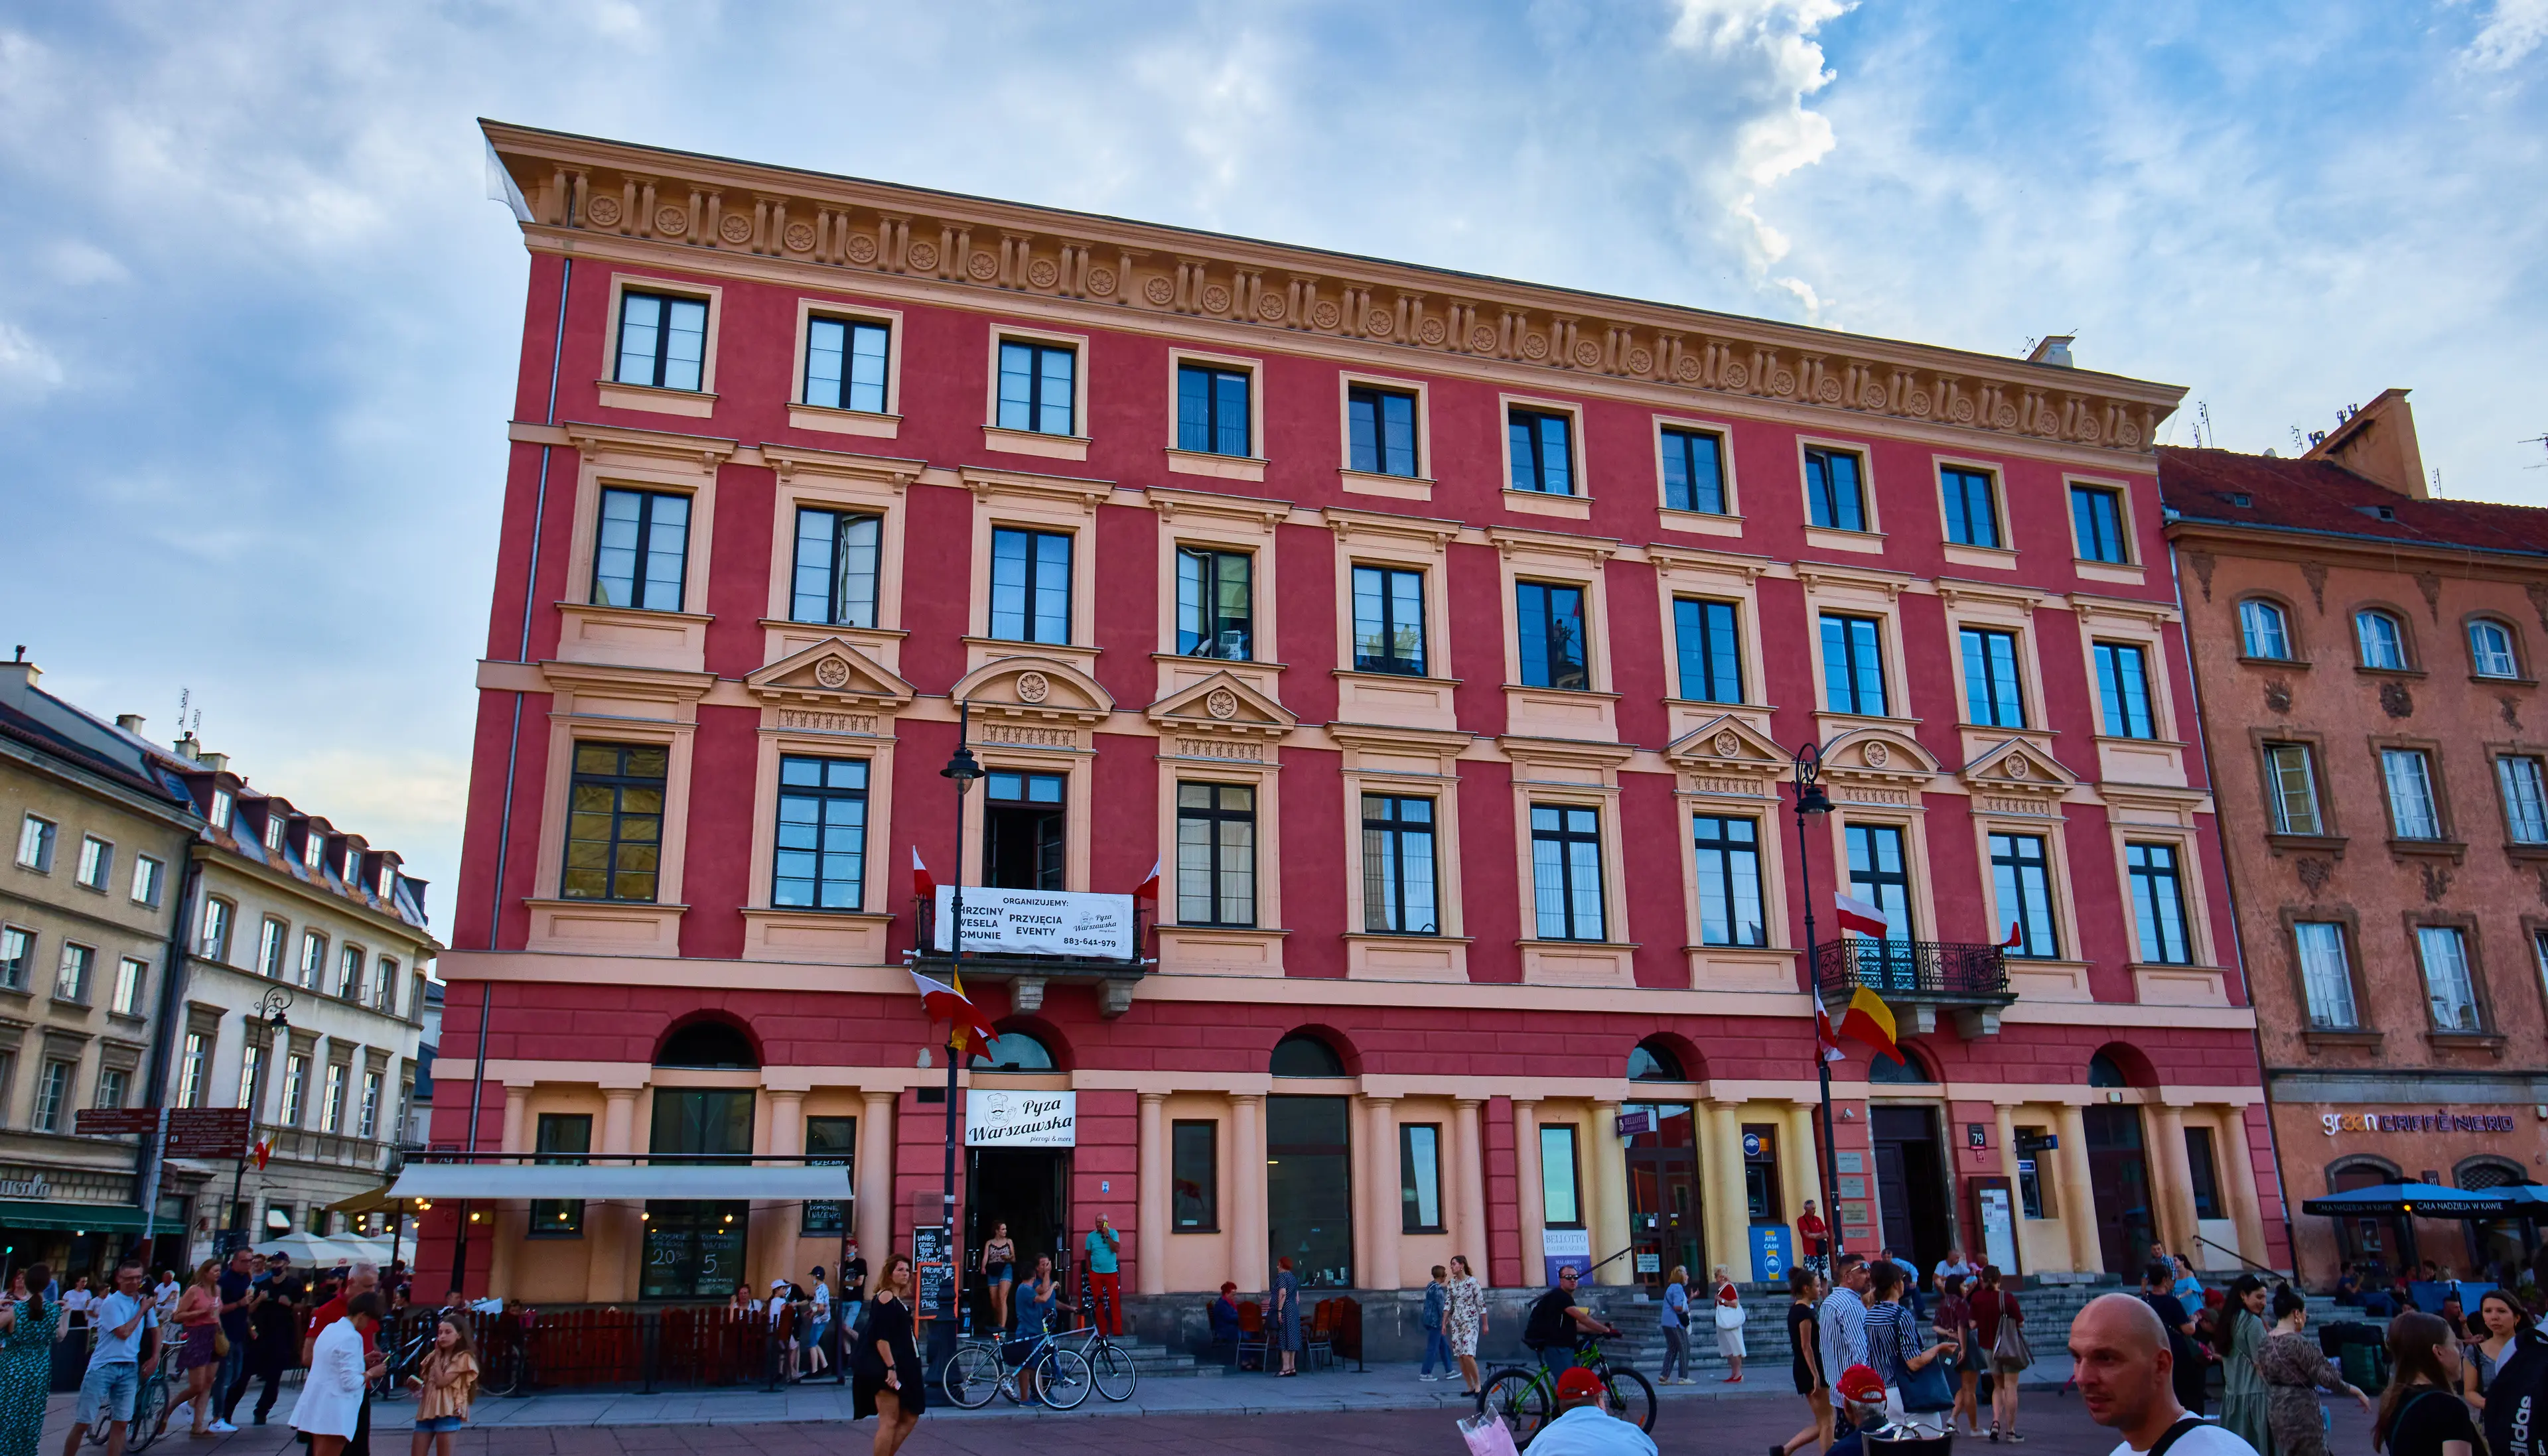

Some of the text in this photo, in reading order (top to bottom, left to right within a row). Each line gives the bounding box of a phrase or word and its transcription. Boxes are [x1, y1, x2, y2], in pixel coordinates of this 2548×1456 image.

[1003, 897, 1069, 907] ORGANIZUJEMY:
[1009, 914, 1062, 925] PRZYJĘCIA
[1016, 927, 1056, 936] EVENTY
[1073, 921, 1117, 932] Warszawska
[961, 931, 1001, 939] OMUNIE
[1064, 937, 1116, 947] 883-641-979
[1023, 1099, 1061, 1117] Pyza
[969, 1116, 1072, 1142] Warszawska
[2322, 1113, 2378, 1136] green
[2453, 1114, 2514, 1132] NERO
[1973, 1133, 1983, 1144] 79
[2437, 1202, 2470, 1211] NADZIEJA
[2480, 1202, 2504, 1211] KAWIE
[1545, 1234, 1586, 1243] BELLOTTO
